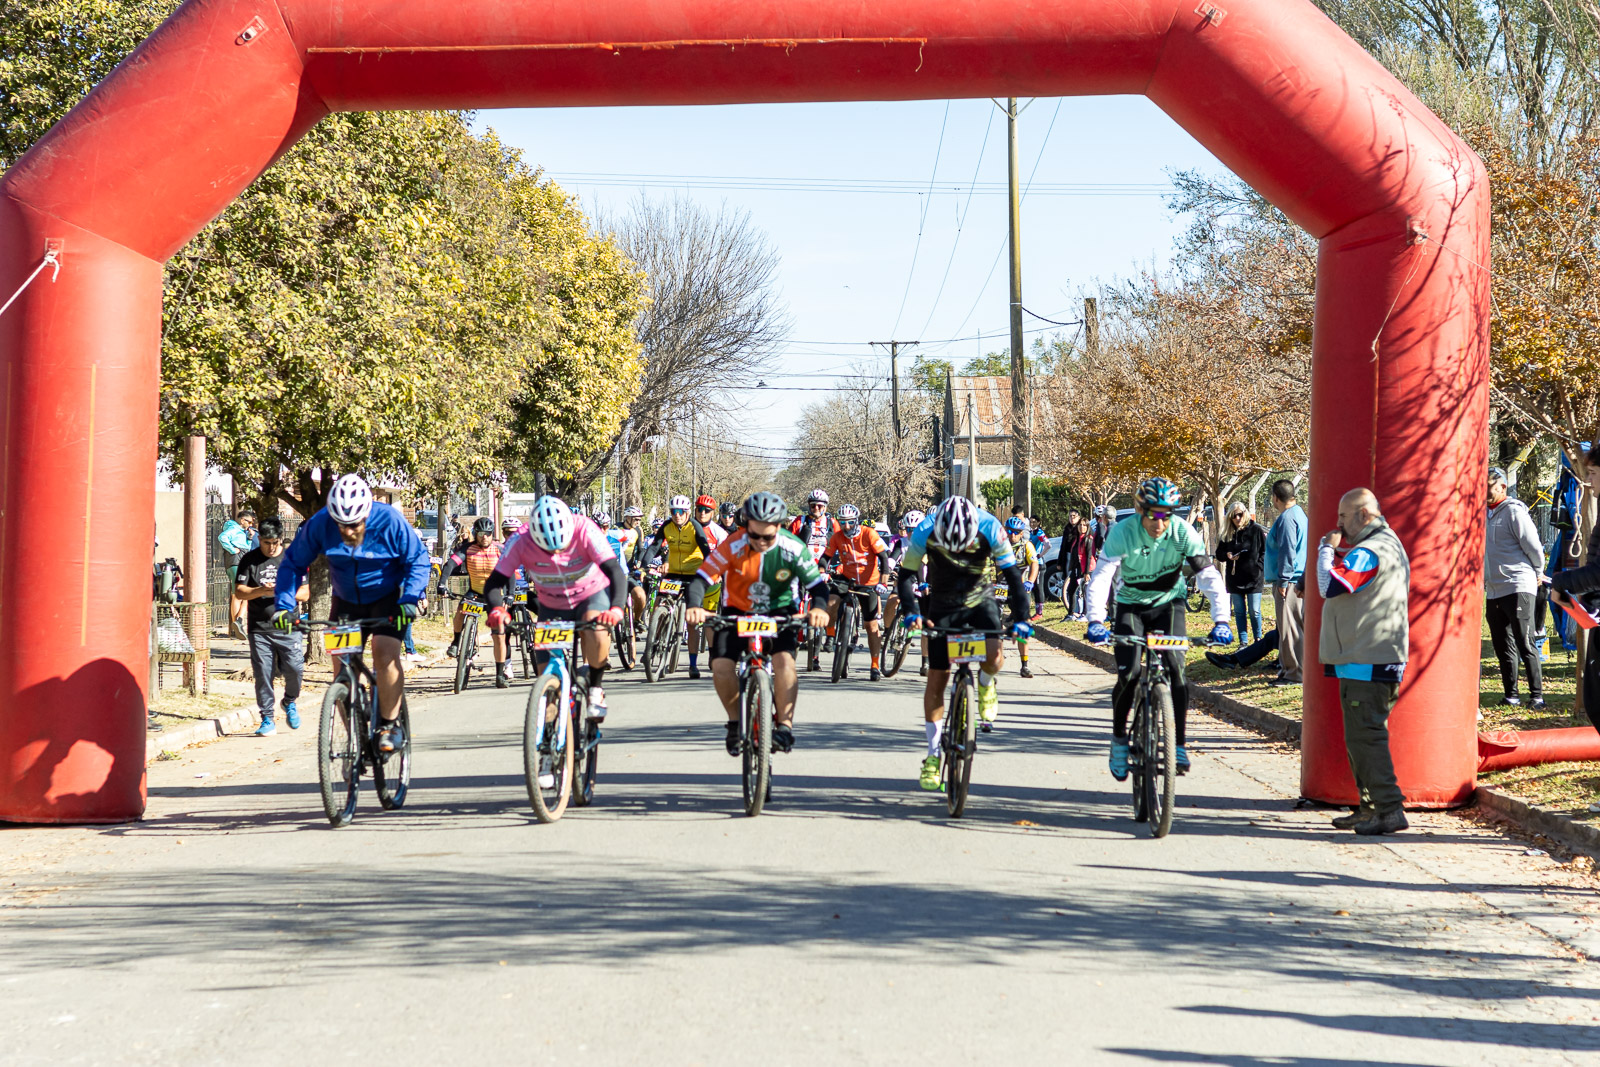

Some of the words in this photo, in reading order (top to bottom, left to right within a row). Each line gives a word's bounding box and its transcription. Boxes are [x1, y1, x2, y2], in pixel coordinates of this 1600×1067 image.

[466, 603, 482, 614] 144
[746, 621, 769, 632] 116
[333, 632, 350, 648] 71
[540, 629, 570, 643] 145
[957, 641, 976, 657] 14
